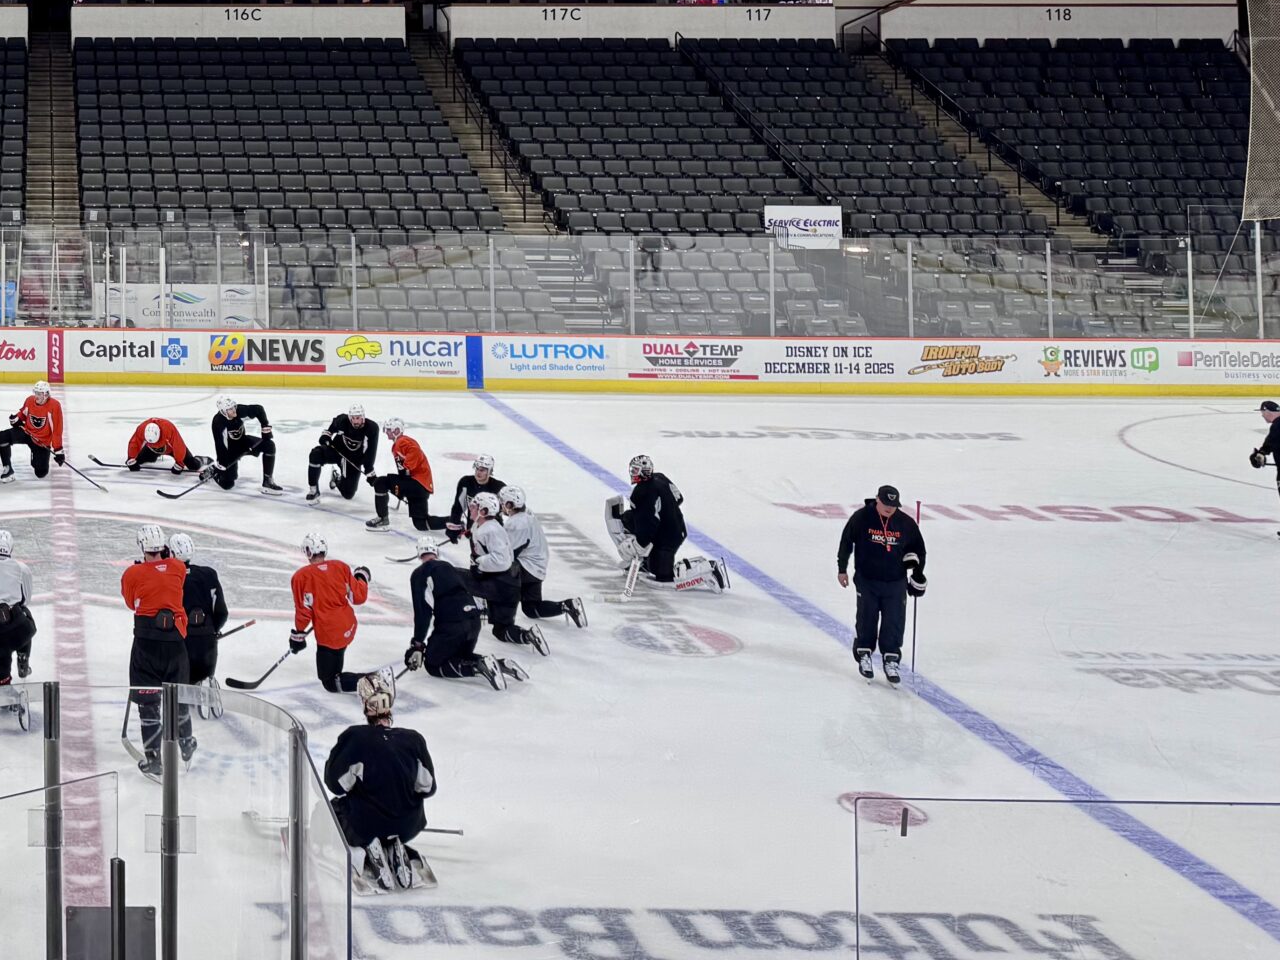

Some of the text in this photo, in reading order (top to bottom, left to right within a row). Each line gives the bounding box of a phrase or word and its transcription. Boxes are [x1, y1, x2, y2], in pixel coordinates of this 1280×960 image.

[224, 8, 262, 21] 116C
[542, 8, 581, 21] 117C
[745, 8, 771, 21] 117
[1045, 8, 1072, 21] 118
[768, 218, 840, 227] SERVICE ELECTRIC
[51, 333, 60, 375] CCM
[79, 339, 155, 362] Capital
[208, 333, 325, 366] 69 NEWS
[389, 339, 463, 358] nucar
[510, 343, 604, 359] LUTRON
[643, 343, 744, 357] DUAL TEMP
[785, 346, 873, 358] DISNEY ON ICE
[920, 345, 981, 361] IRONTON
[390, 357, 453, 368] of Allentown
[659, 358, 723, 366] HOME SERVICES
[1064, 349, 1157, 368] REVIEWS UP
[510, 363, 605, 372] Light and Shade Control
[764, 362, 895, 375] DECEMBER 11-14 2025
[942, 359, 1005, 377] AUTO BODY
[1064, 369, 1128, 377] MORE STAR REVIEWS
[1224, 371, 1260, 379] business
